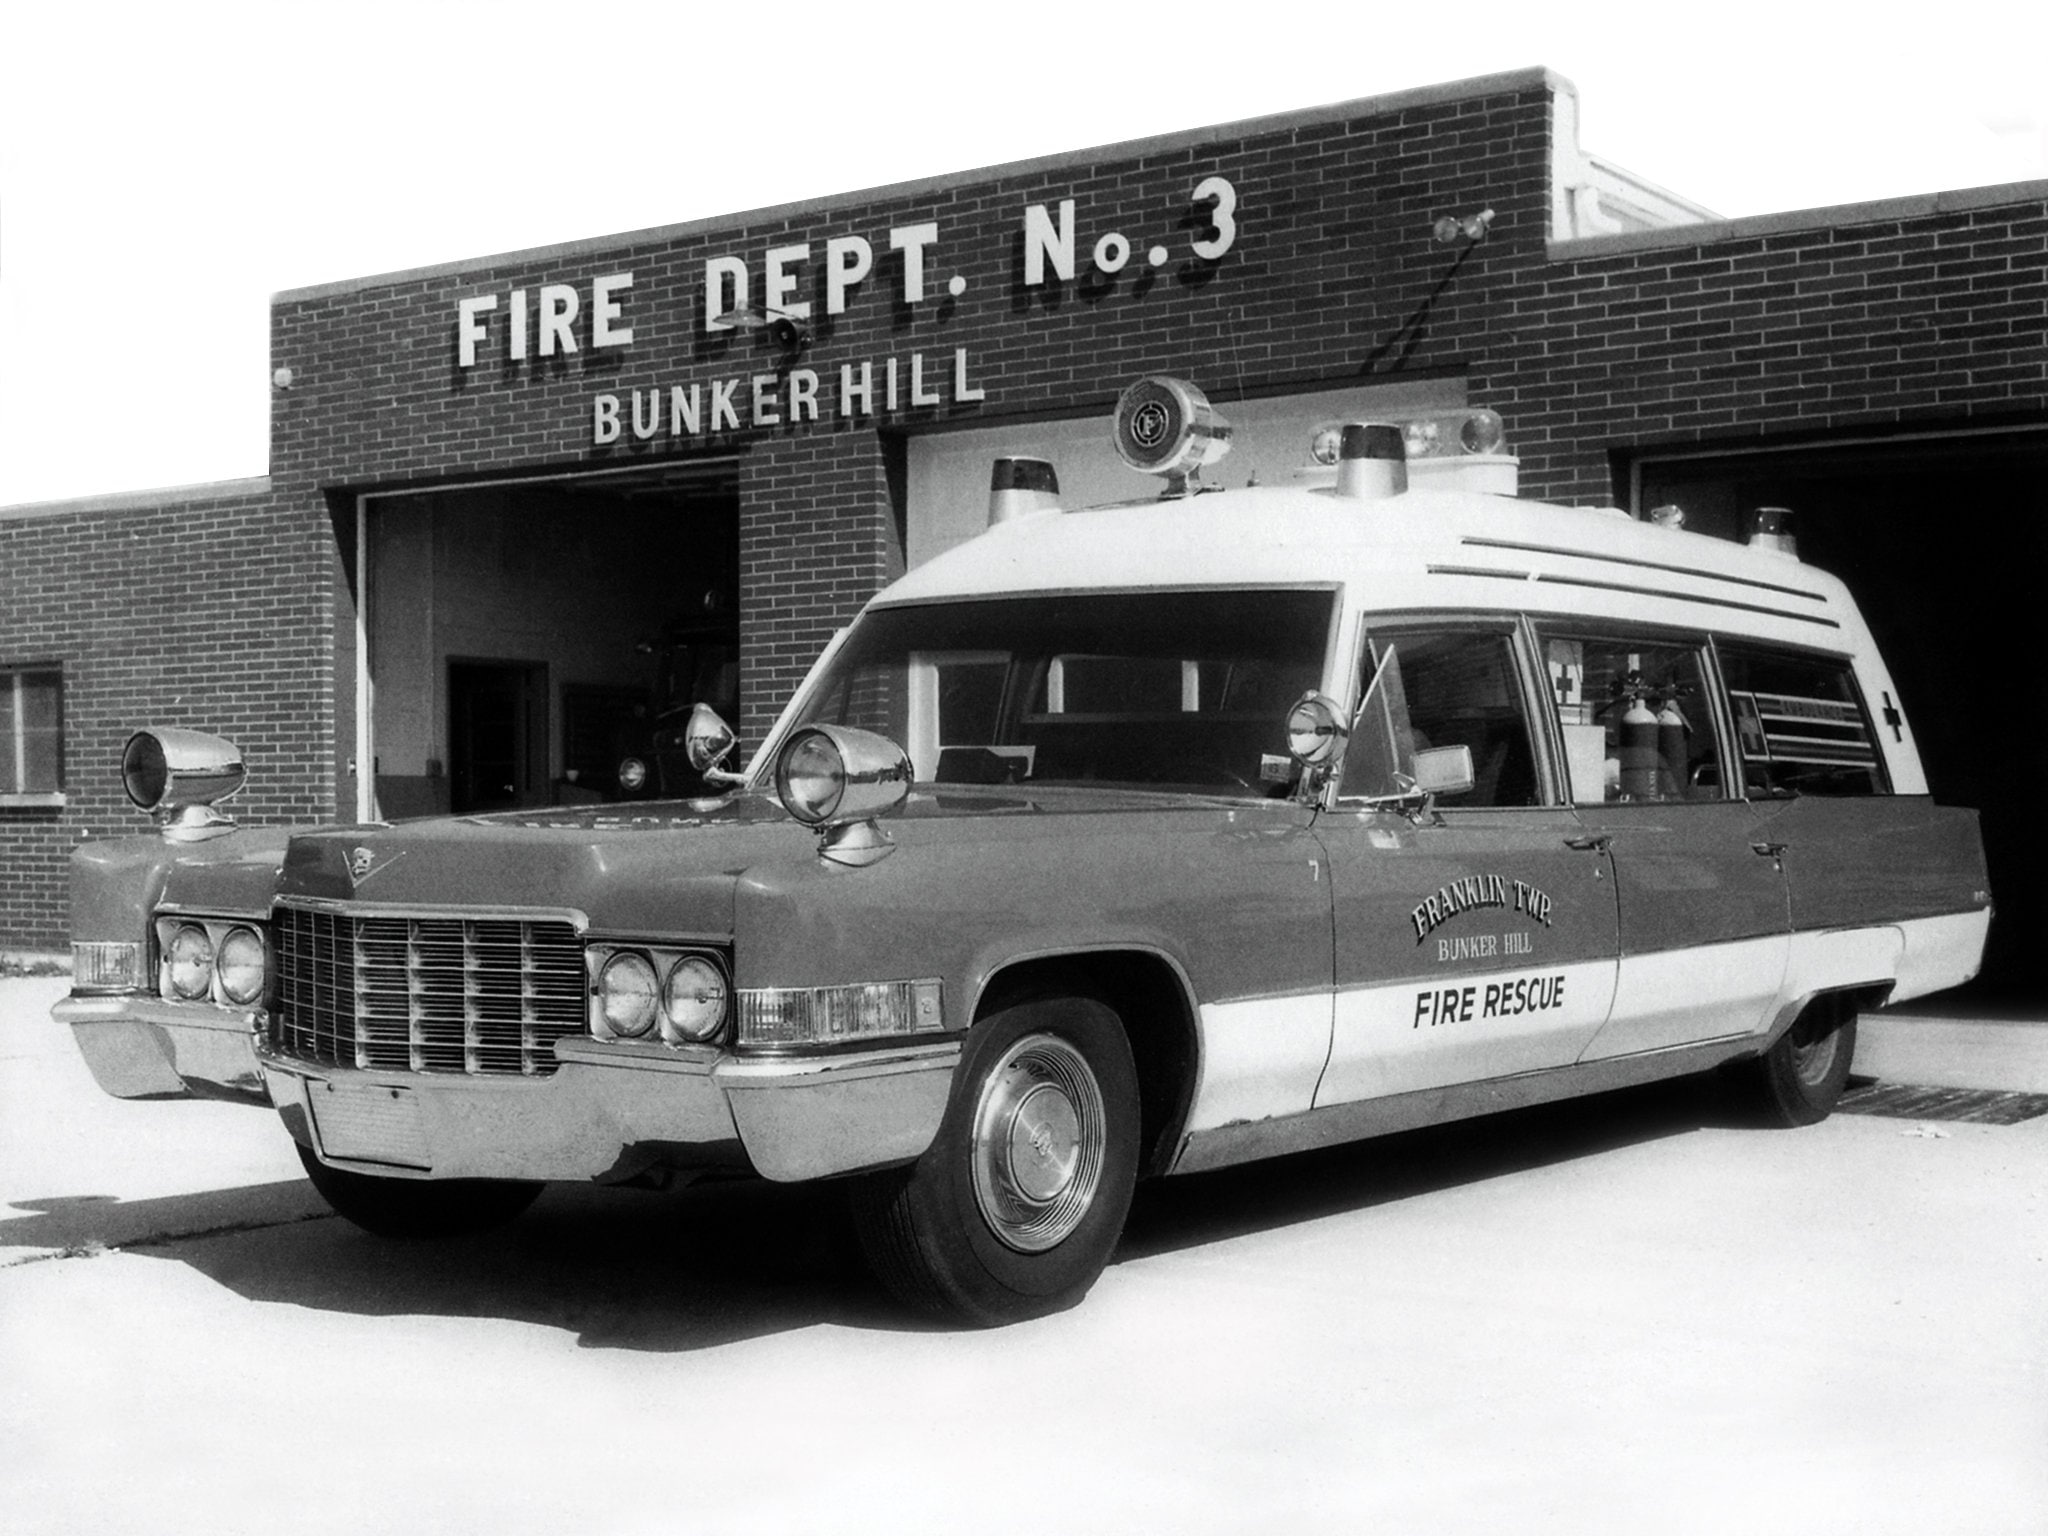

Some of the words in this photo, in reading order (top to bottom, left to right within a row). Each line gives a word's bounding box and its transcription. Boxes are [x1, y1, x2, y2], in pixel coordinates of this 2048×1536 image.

[459, 272, 634, 367] FIRE
[705, 222, 967, 332] DEPT.
[1024, 199, 1169, 286] No.
[1191, 176, 1237, 260] 3
[1411, 874, 1505, 946] FRANKLIN
[1513, 879, 1552, 928] TWP.
[1437, 935, 1498, 962] BUNKER
[1504, 932, 1533, 955] HILL
[1413, 986, 1476, 1029] FIRE
[1482, 975, 1566, 1018] RESCUE
